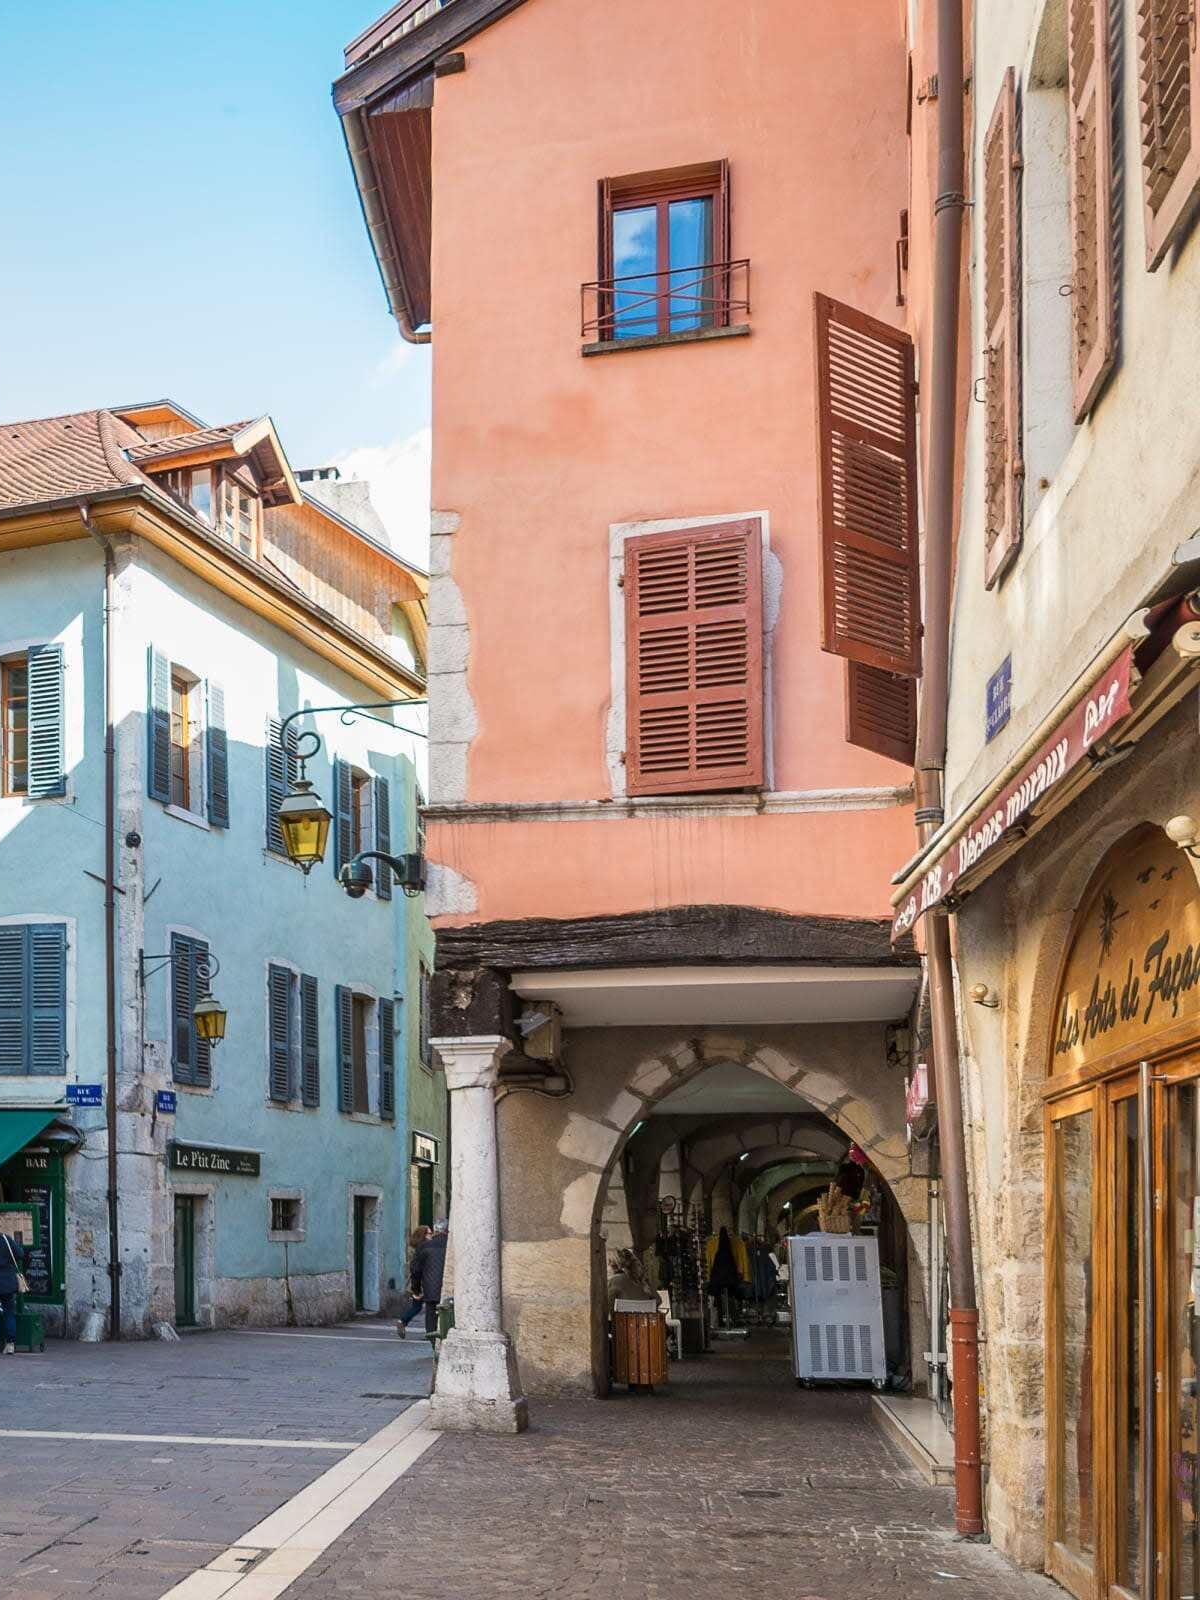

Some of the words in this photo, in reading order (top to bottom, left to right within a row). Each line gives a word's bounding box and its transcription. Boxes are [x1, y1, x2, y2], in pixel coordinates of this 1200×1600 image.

[1006, 737, 1069, 828] muraux
[1082, 972, 1117, 1046] Arts
[1120, 958, 1140, 1021] de
[25, 1158, 47, 1169] BAR
[176, 1149, 189, 1167] Le
[191, 1150, 209, 1169] P'tit
[210, 1153, 230, 1171] Zinc
